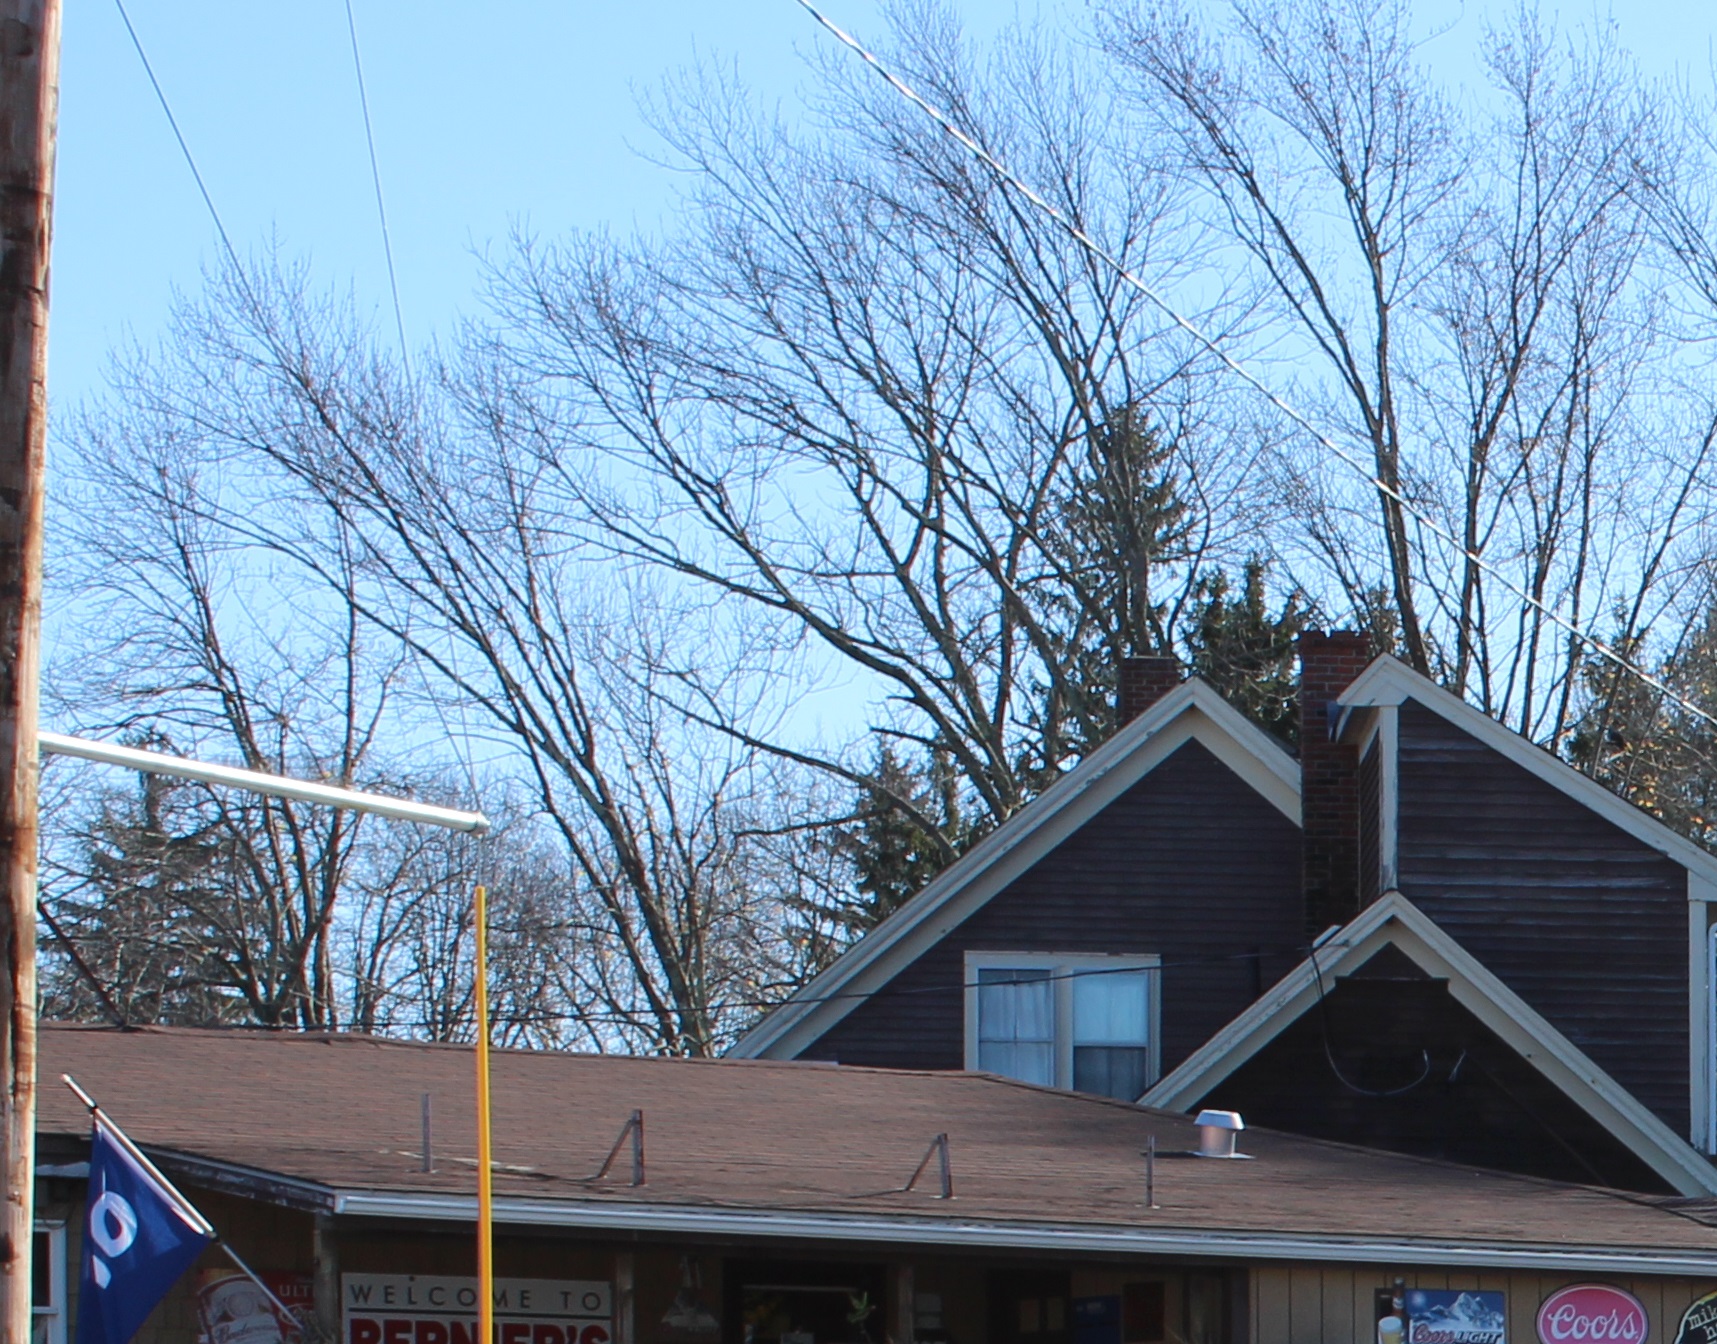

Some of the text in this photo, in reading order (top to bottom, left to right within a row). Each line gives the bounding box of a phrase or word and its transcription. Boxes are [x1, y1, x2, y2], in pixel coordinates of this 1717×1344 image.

[350, 1284, 602, 1312] WELCOME TO
[1548, 1303, 1639, 1341] Coors
